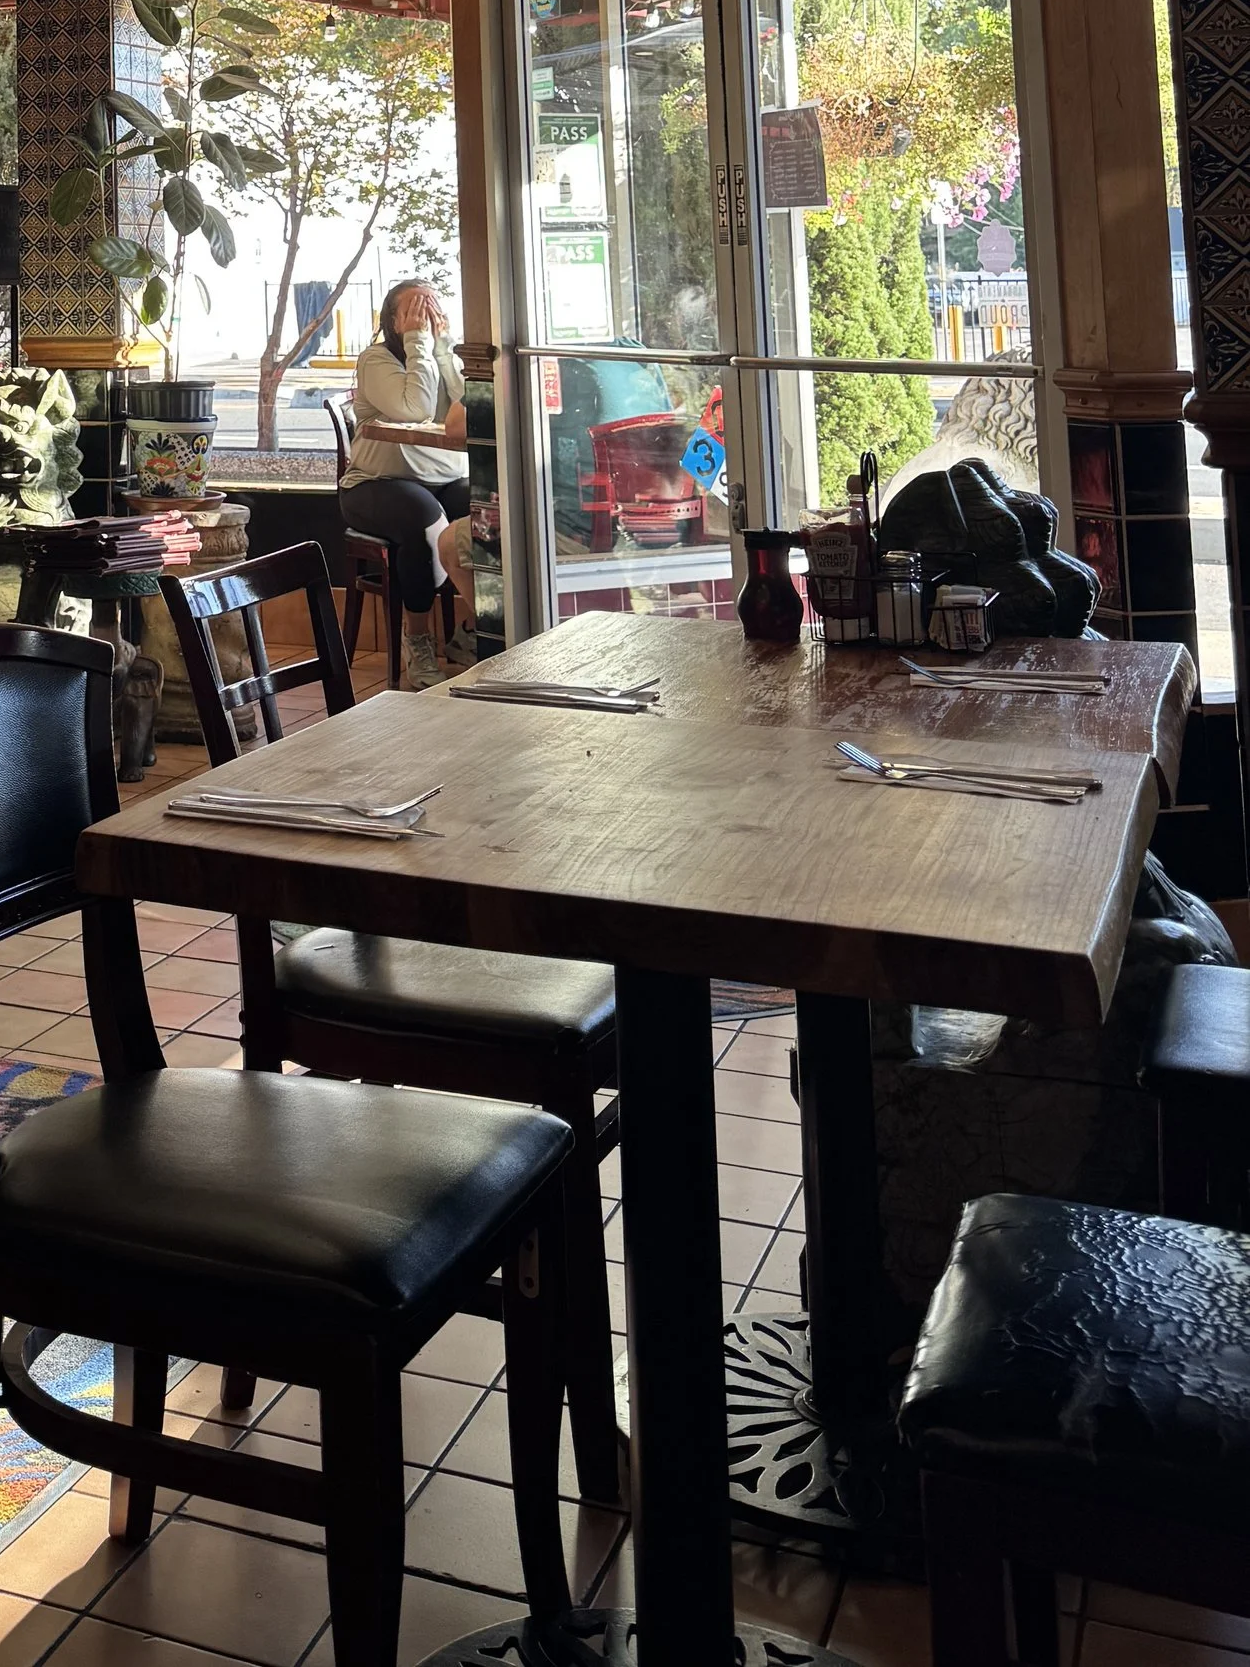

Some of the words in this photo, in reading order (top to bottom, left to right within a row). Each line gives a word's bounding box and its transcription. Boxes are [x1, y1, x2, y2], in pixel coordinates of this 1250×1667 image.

[550, 126, 588, 141] PASS
[717, 170, 727, 227] PUSH
[735, 170, 746, 227] PUSH
[693, 439, 716, 477] 3
[818, 538, 844, 548] HEINZ
[817, 552, 849, 562] TOMATO
